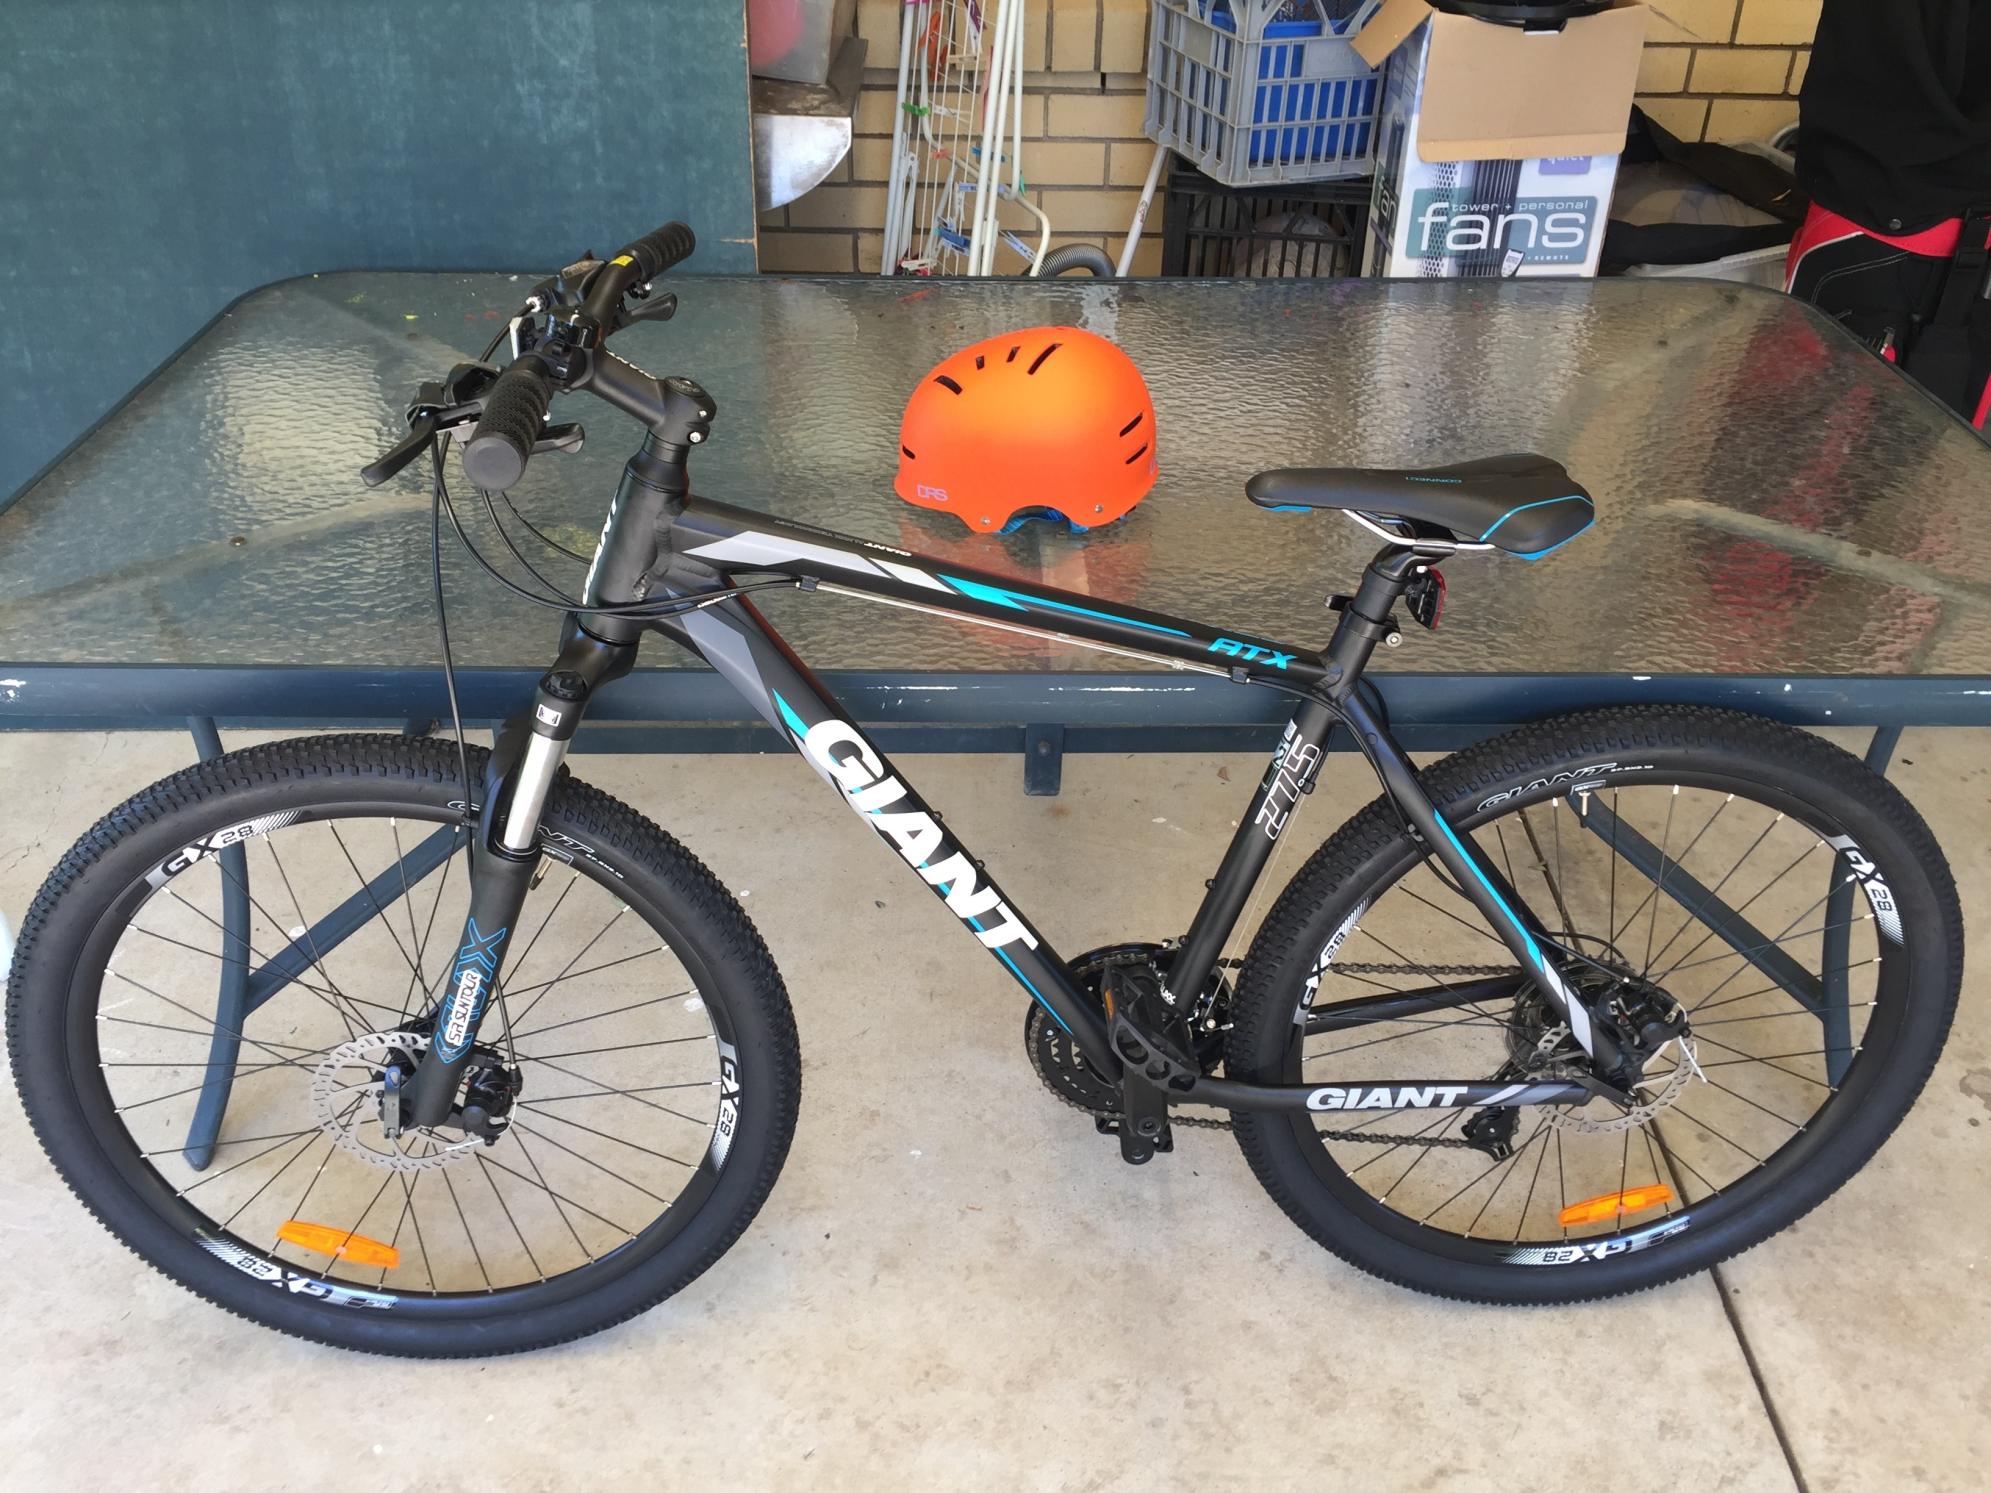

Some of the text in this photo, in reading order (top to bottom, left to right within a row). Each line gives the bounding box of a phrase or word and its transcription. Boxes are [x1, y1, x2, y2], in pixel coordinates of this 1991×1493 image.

[1418, 202, 1586, 251] fans
[1452, 202, 1499, 212] tower
[1519, 200, 1588, 211] personal
[1207, 637, 1298, 670] ATX
[1477, 762, 1617, 812] GIANT
[804, 719, 1039, 951] GIANT
[449, 972, 478, 1045] SR SUNTOUR
[1306, 1086, 1468, 1110] GIANT
